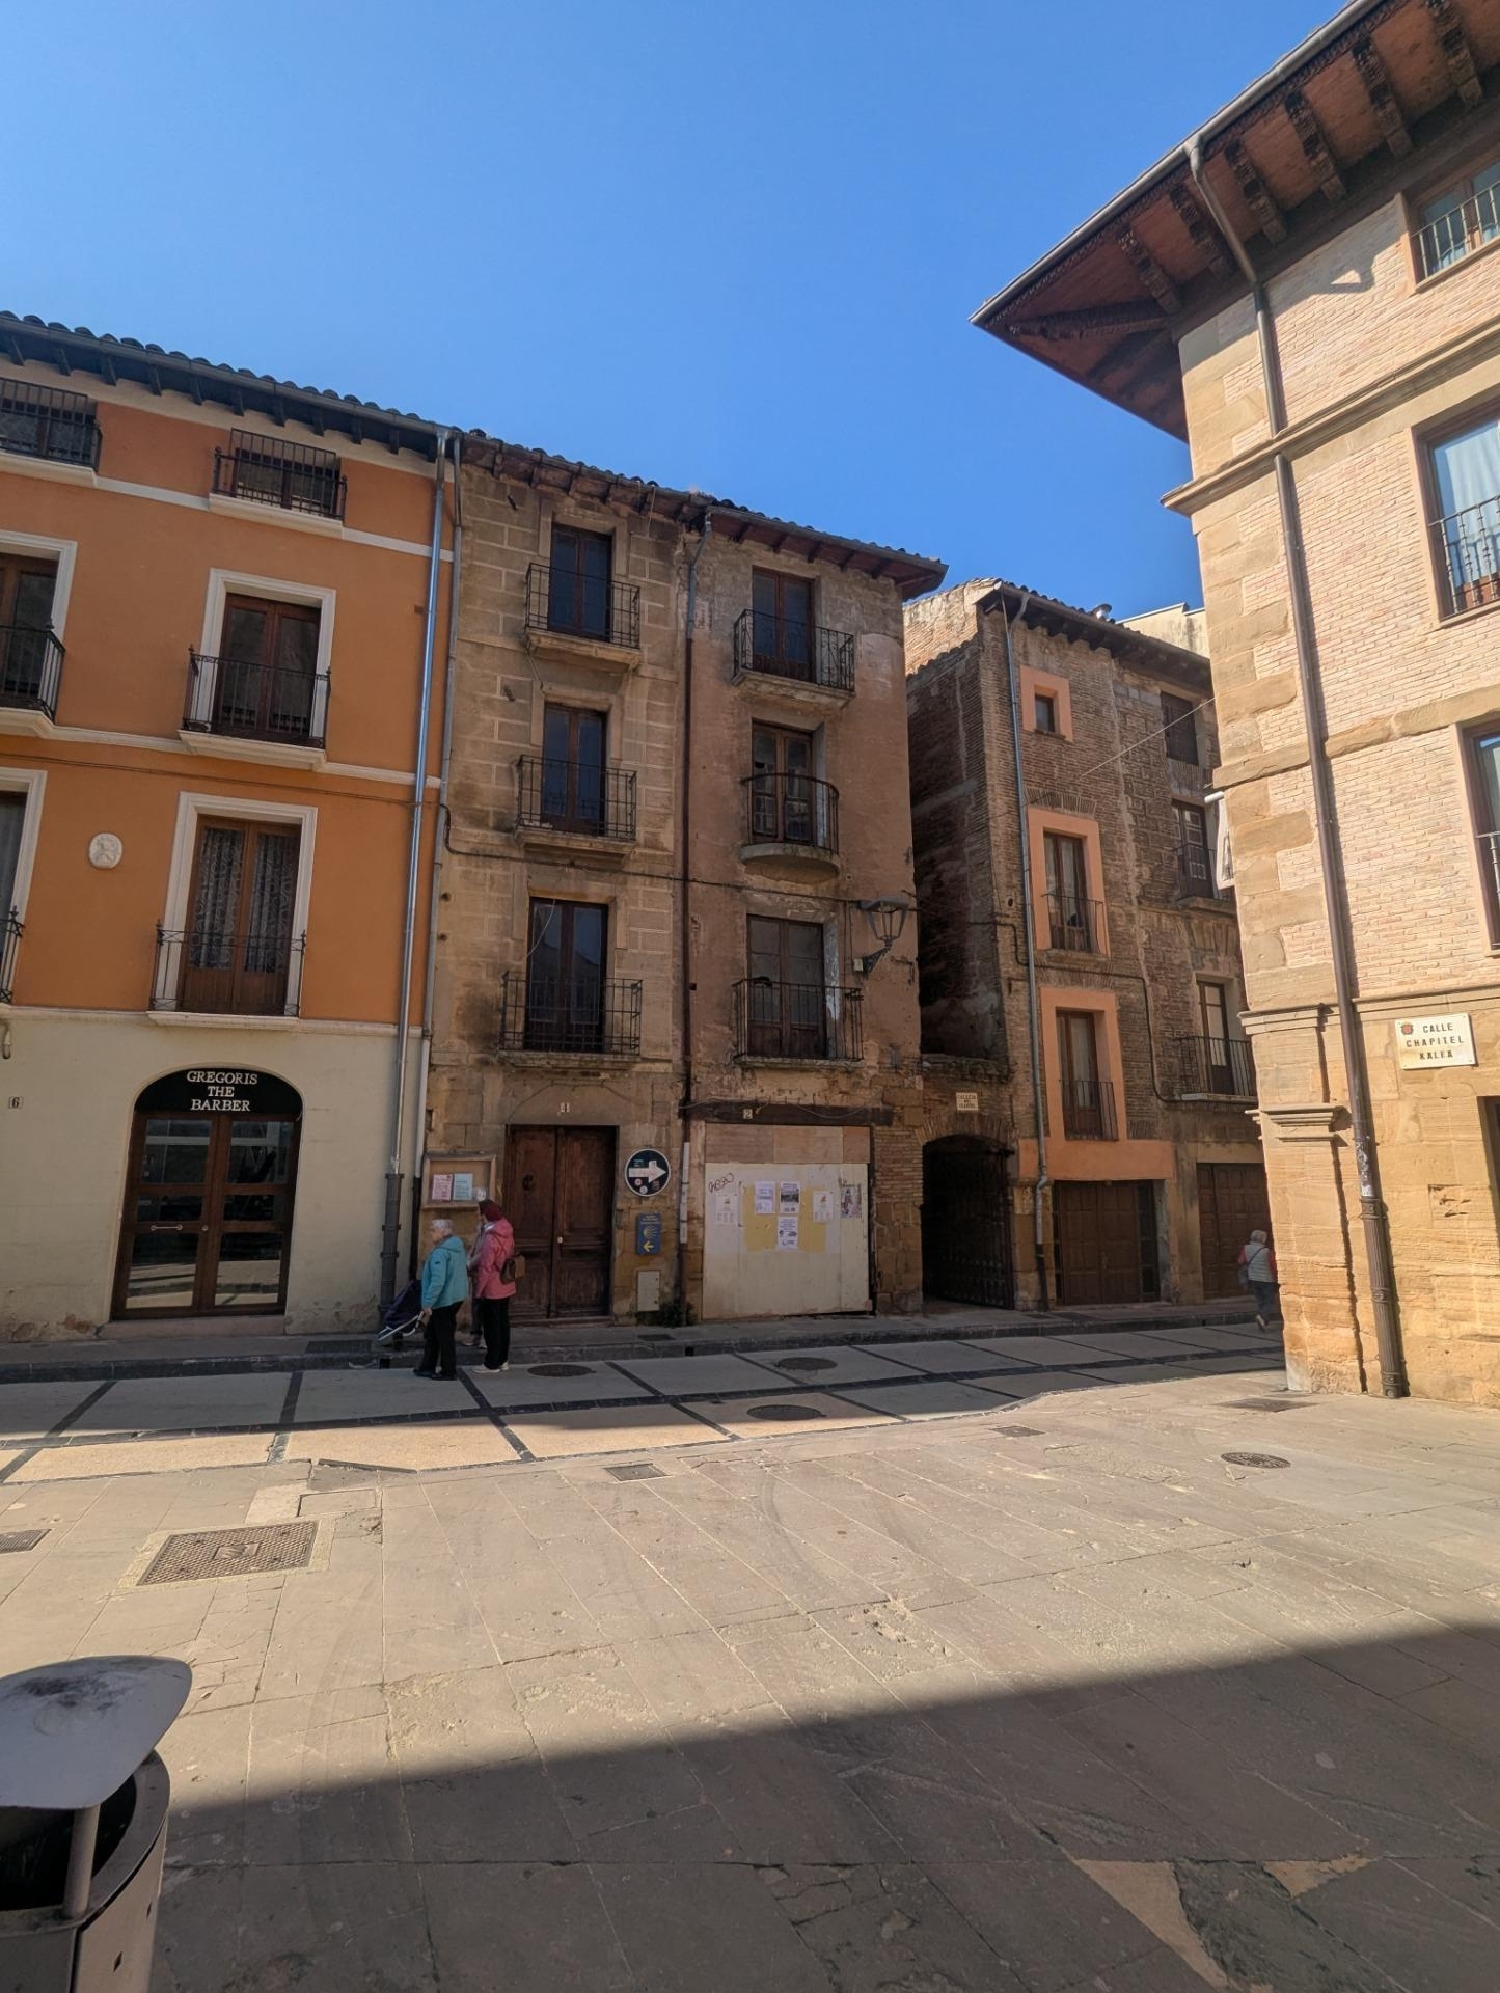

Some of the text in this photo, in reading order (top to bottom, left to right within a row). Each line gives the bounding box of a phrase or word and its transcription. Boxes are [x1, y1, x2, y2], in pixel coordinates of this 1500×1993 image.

[1422, 1022, 1453, 1033] CALLE
[1406, 1035, 1465, 1047] CHAPITEL
[187, 1070, 258, 1085] GREGORIS
[208, 1086, 235, 1097] THE
[191, 1099, 251, 1112] BARBER
